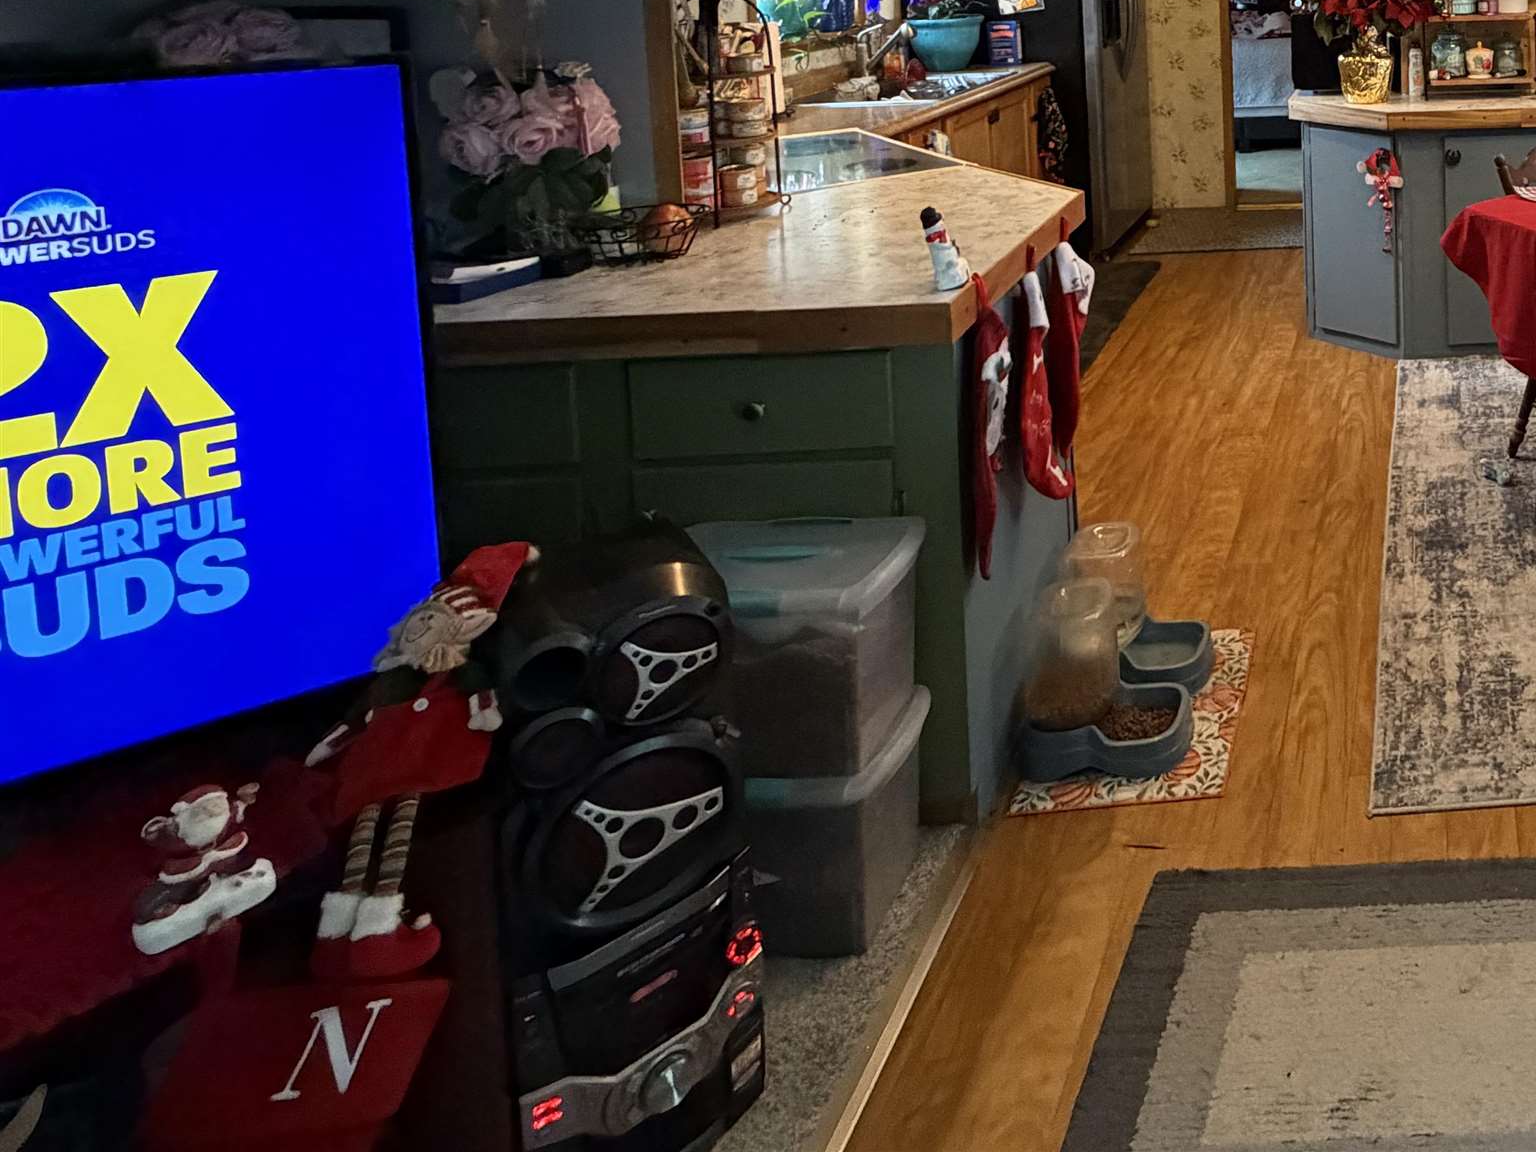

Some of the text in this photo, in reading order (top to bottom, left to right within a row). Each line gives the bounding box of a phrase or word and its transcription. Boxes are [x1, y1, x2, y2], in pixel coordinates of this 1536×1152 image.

[2, 208, 104, 240] DAWN
[0, 422, 242, 539] ORE
[0, 537, 250, 658] UDS
